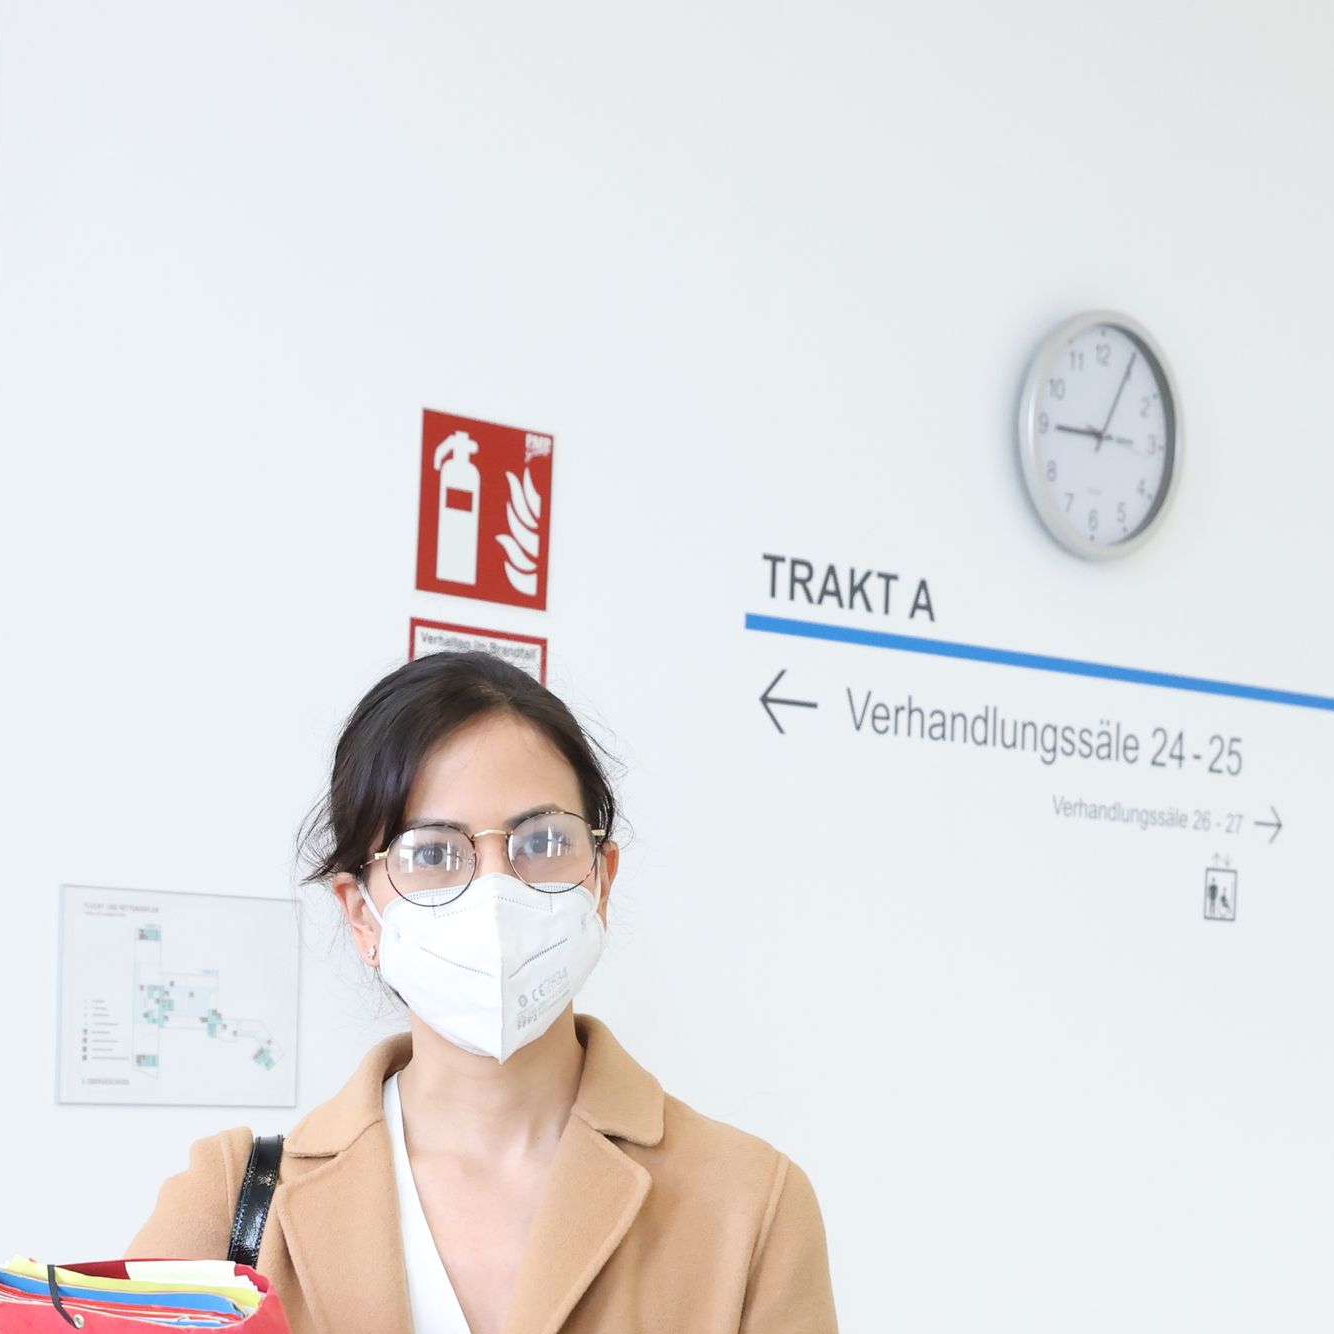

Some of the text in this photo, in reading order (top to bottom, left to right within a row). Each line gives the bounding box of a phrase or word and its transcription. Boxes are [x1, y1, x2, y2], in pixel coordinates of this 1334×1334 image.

[1070, 351, 1084, 372] 11
[1096, 344, 1112, 367] 12
[1049, 377, 1066, 400] 10
[1140, 396, 1151, 418] 2
[1038, 412, 1050, 434] 9
[1147, 434, 1157, 455] 3
[1046, 459, 1057, 482] 8
[1065, 492, 1075, 512] 7
[1117, 501, 1127, 523] 5
[1088, 509, 1098, 531] 6
[763, 553, 936, 622] TRAKT A
[846, 687, 1140, 766] Verhandlungssäle
[1052, 794, 1188, 830] Verhandlungssäle
[1192, 809, 1212, 833] 26
[1225, 813, 1244, 835] 27
